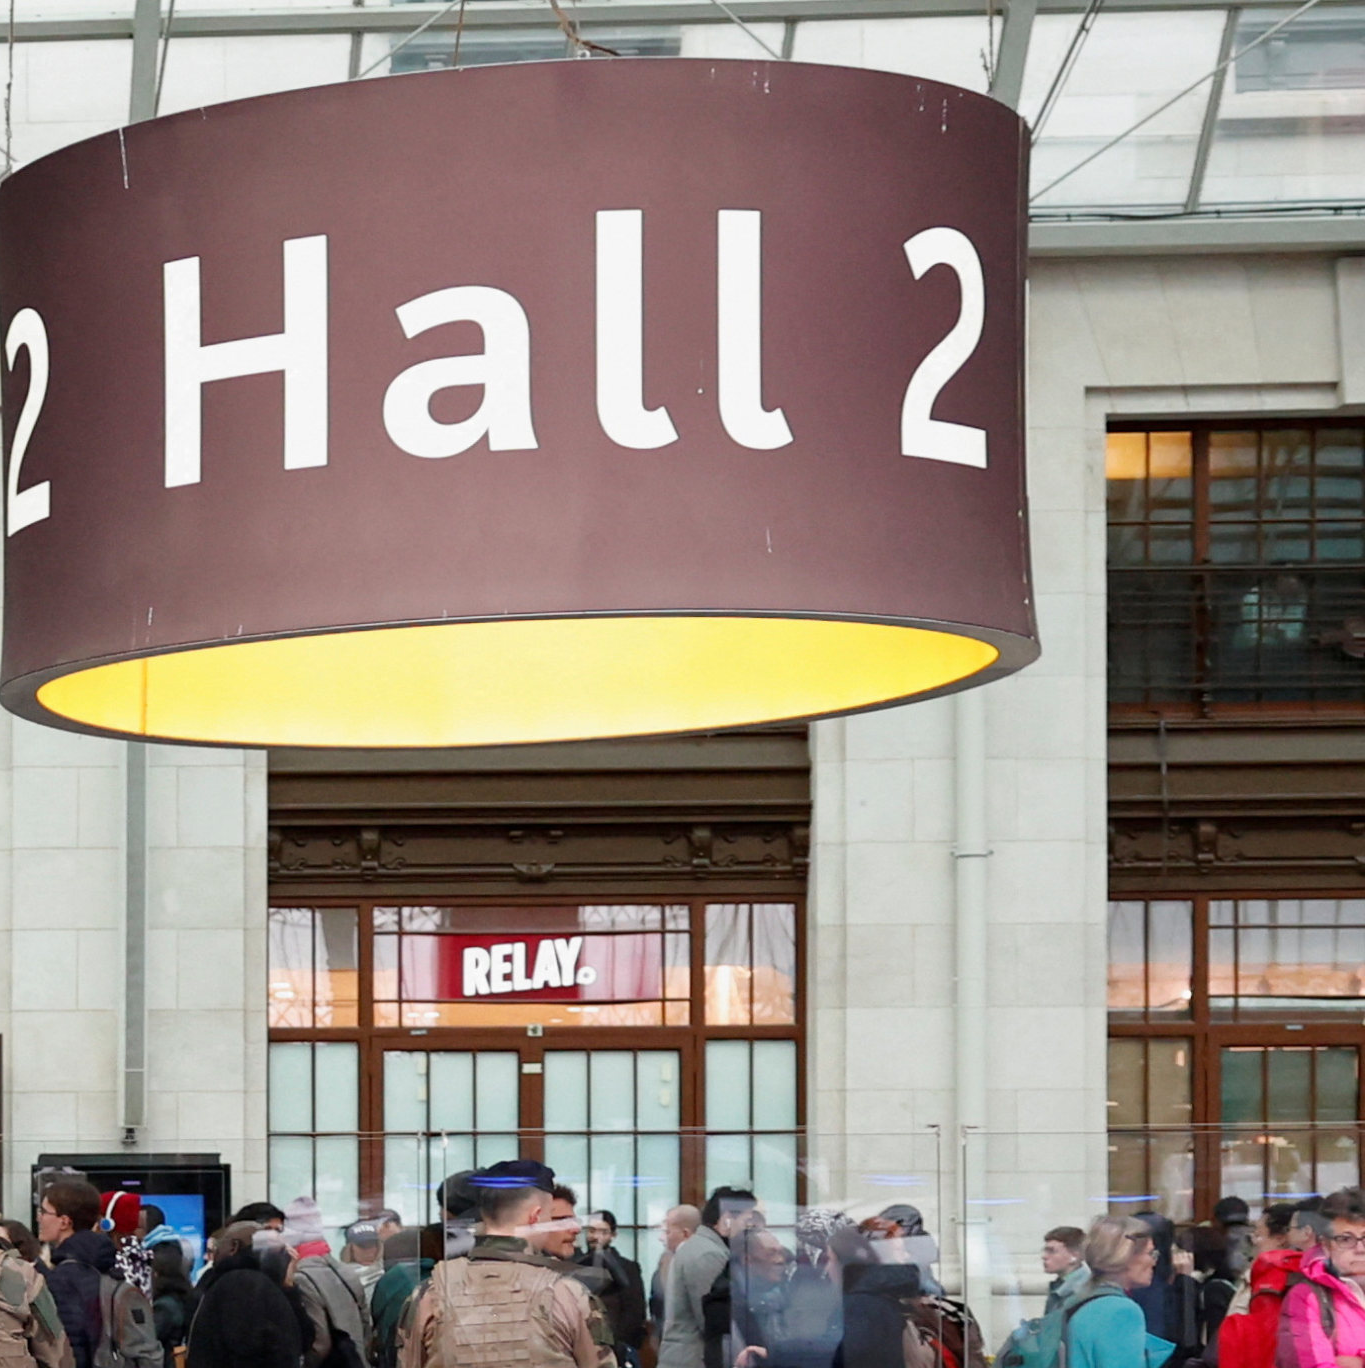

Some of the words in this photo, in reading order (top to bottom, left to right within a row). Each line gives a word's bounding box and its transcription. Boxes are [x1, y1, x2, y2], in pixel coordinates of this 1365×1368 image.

[5, 307, 50, 537] 2
[163, 208, 794, 489] Hall
[901, 226, 988, 469] 2
[462, 936, 583, 996] RELAY
